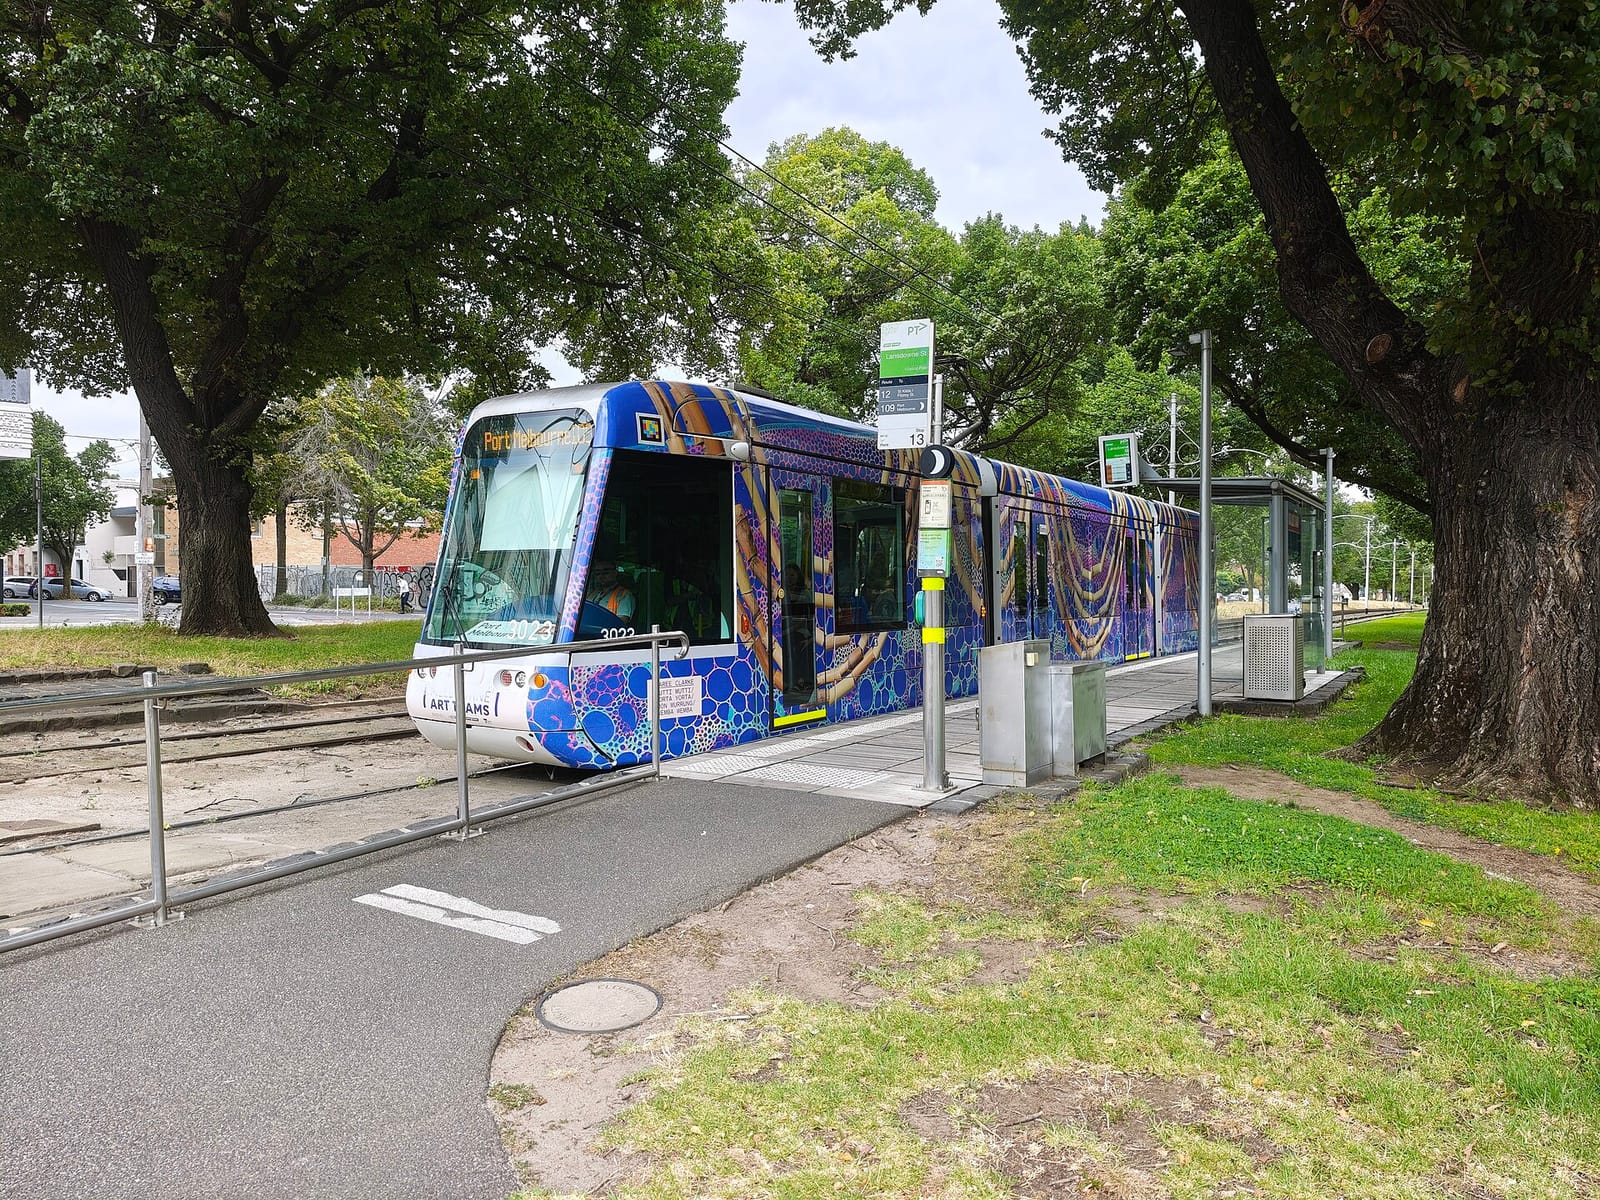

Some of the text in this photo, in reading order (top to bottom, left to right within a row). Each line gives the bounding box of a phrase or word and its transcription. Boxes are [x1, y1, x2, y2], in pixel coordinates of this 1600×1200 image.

[881, 390, 891, 399] 12
[881, 403, 895, 413] 109
[484, 430, 510, 451] Port
[513, 428, 571, 449] Melbourne
[909, 433, 925, 446] 13
[479, 622, 502, 630] Port
[510, 619, 552, 641] 3023
[430, 698, 490, 716] ART TAMS
